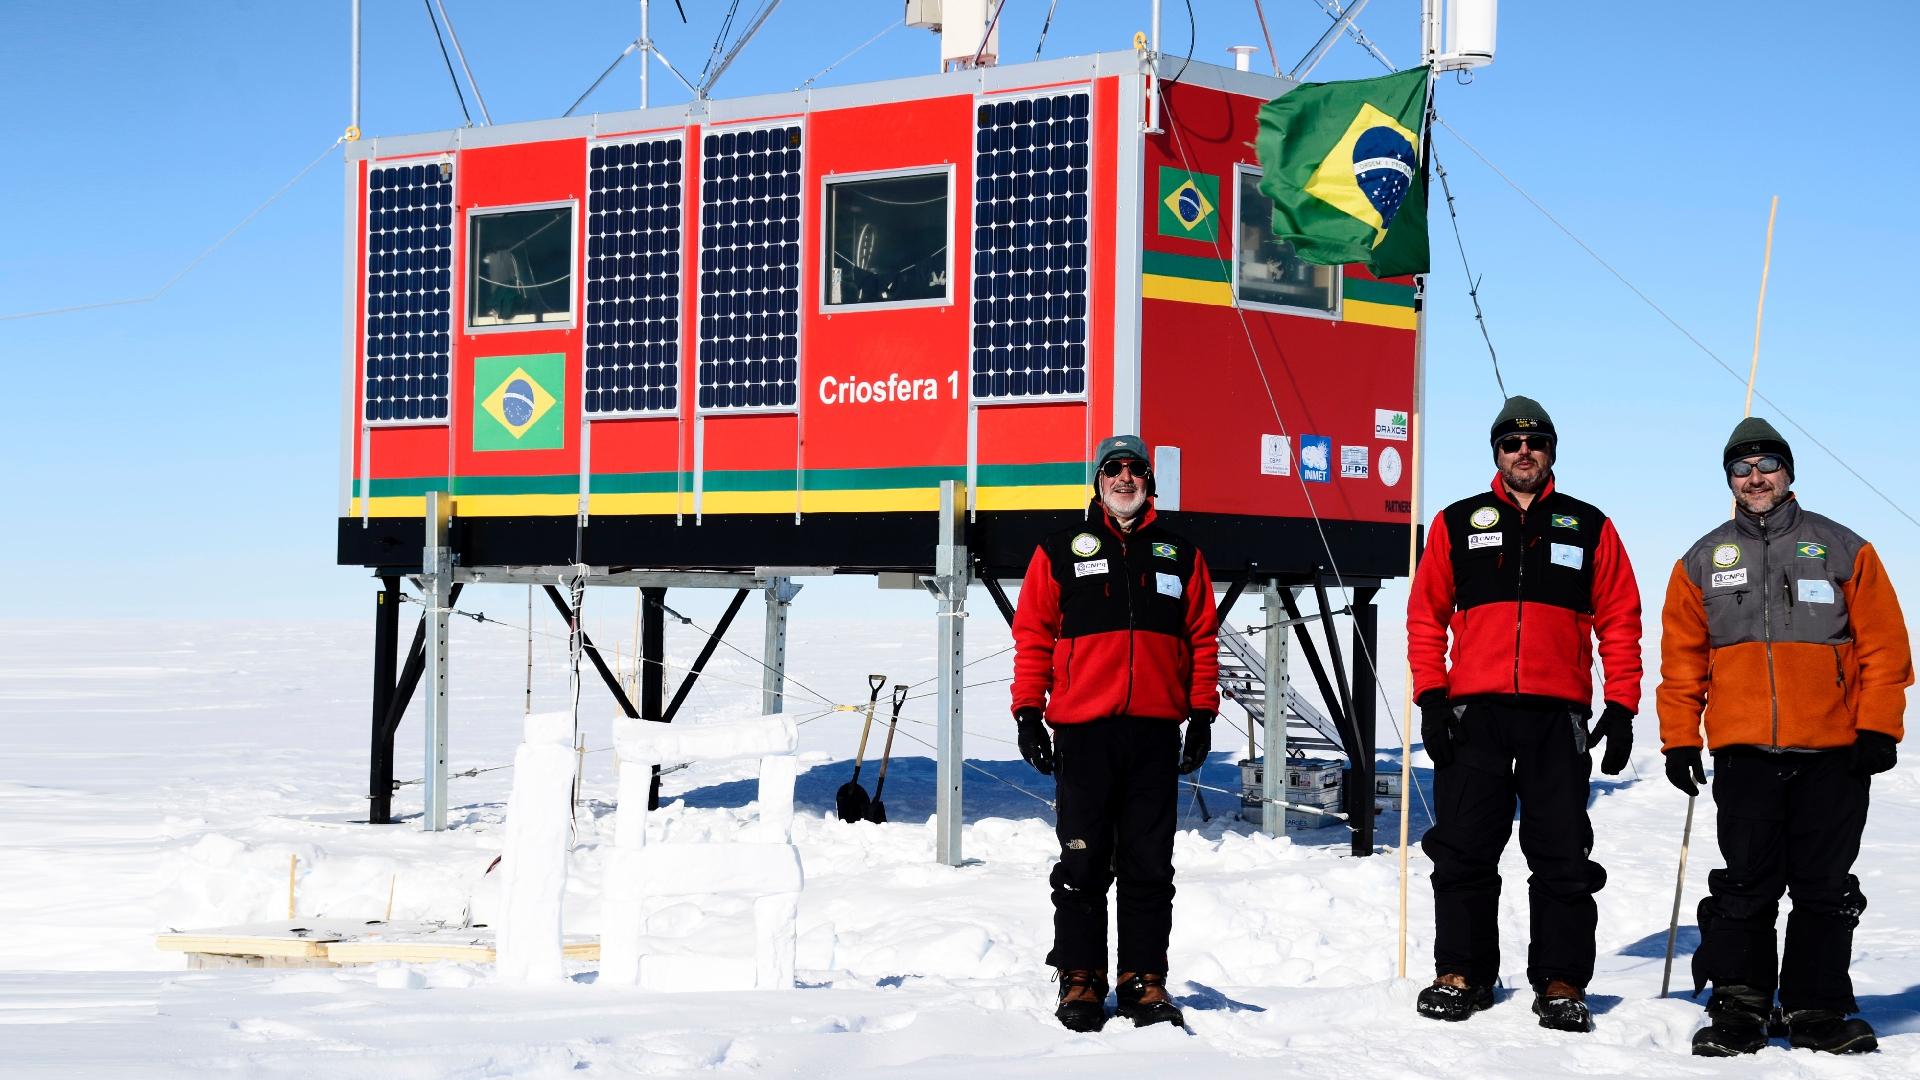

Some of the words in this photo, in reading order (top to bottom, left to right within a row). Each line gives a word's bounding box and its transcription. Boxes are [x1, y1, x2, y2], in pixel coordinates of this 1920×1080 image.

[819, 373, 938, 405] Criosfera
[947, 370, 959, 400] 1
[1341, 465, 1368, 474] UFPR
[1304, 470, 1327, 481] INMET
